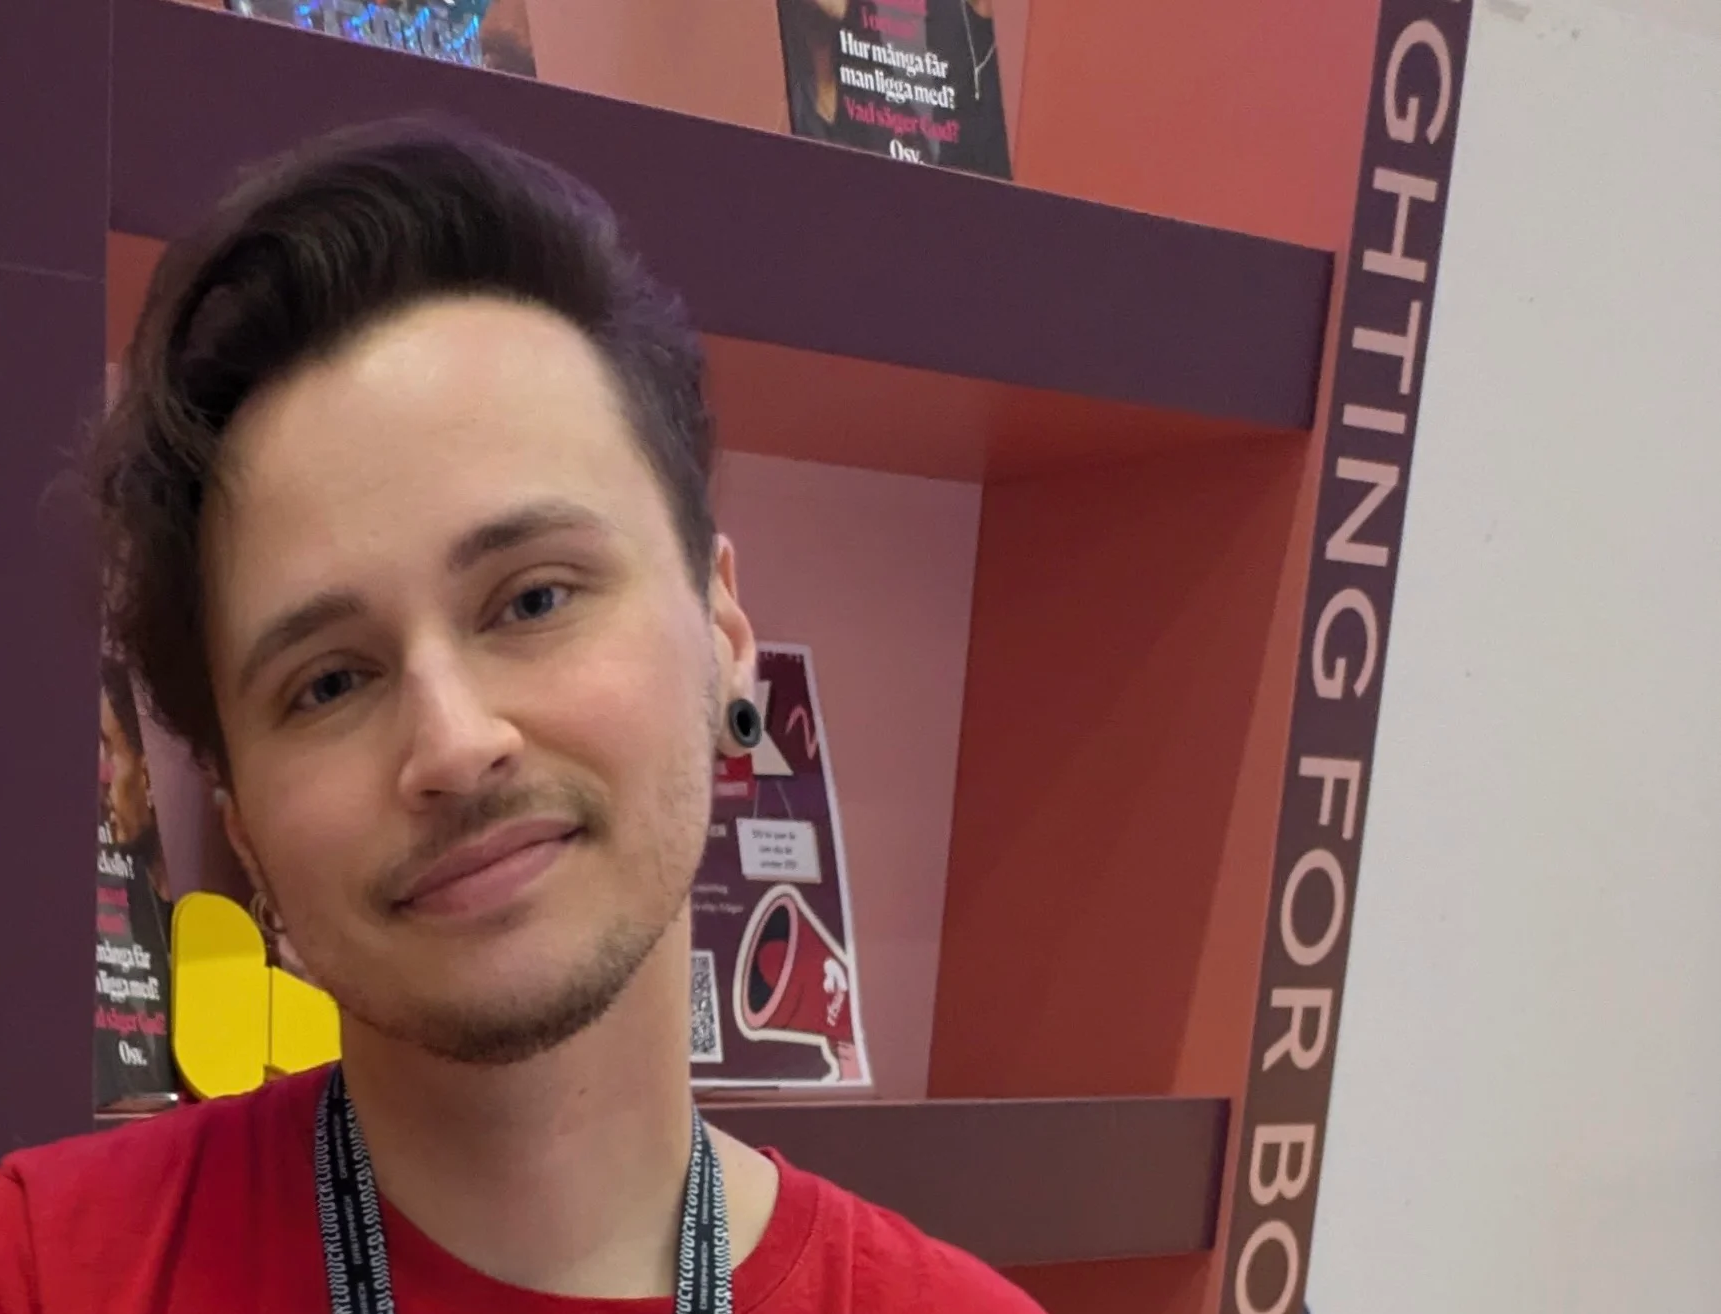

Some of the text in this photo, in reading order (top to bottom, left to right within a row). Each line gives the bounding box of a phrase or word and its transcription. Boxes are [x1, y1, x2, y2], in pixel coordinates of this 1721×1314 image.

[839, 29, 948, 79] Hur många får
[839, 65, 956, 110] man ligga med?
[1262, 756, 1363, 1073] FOR
